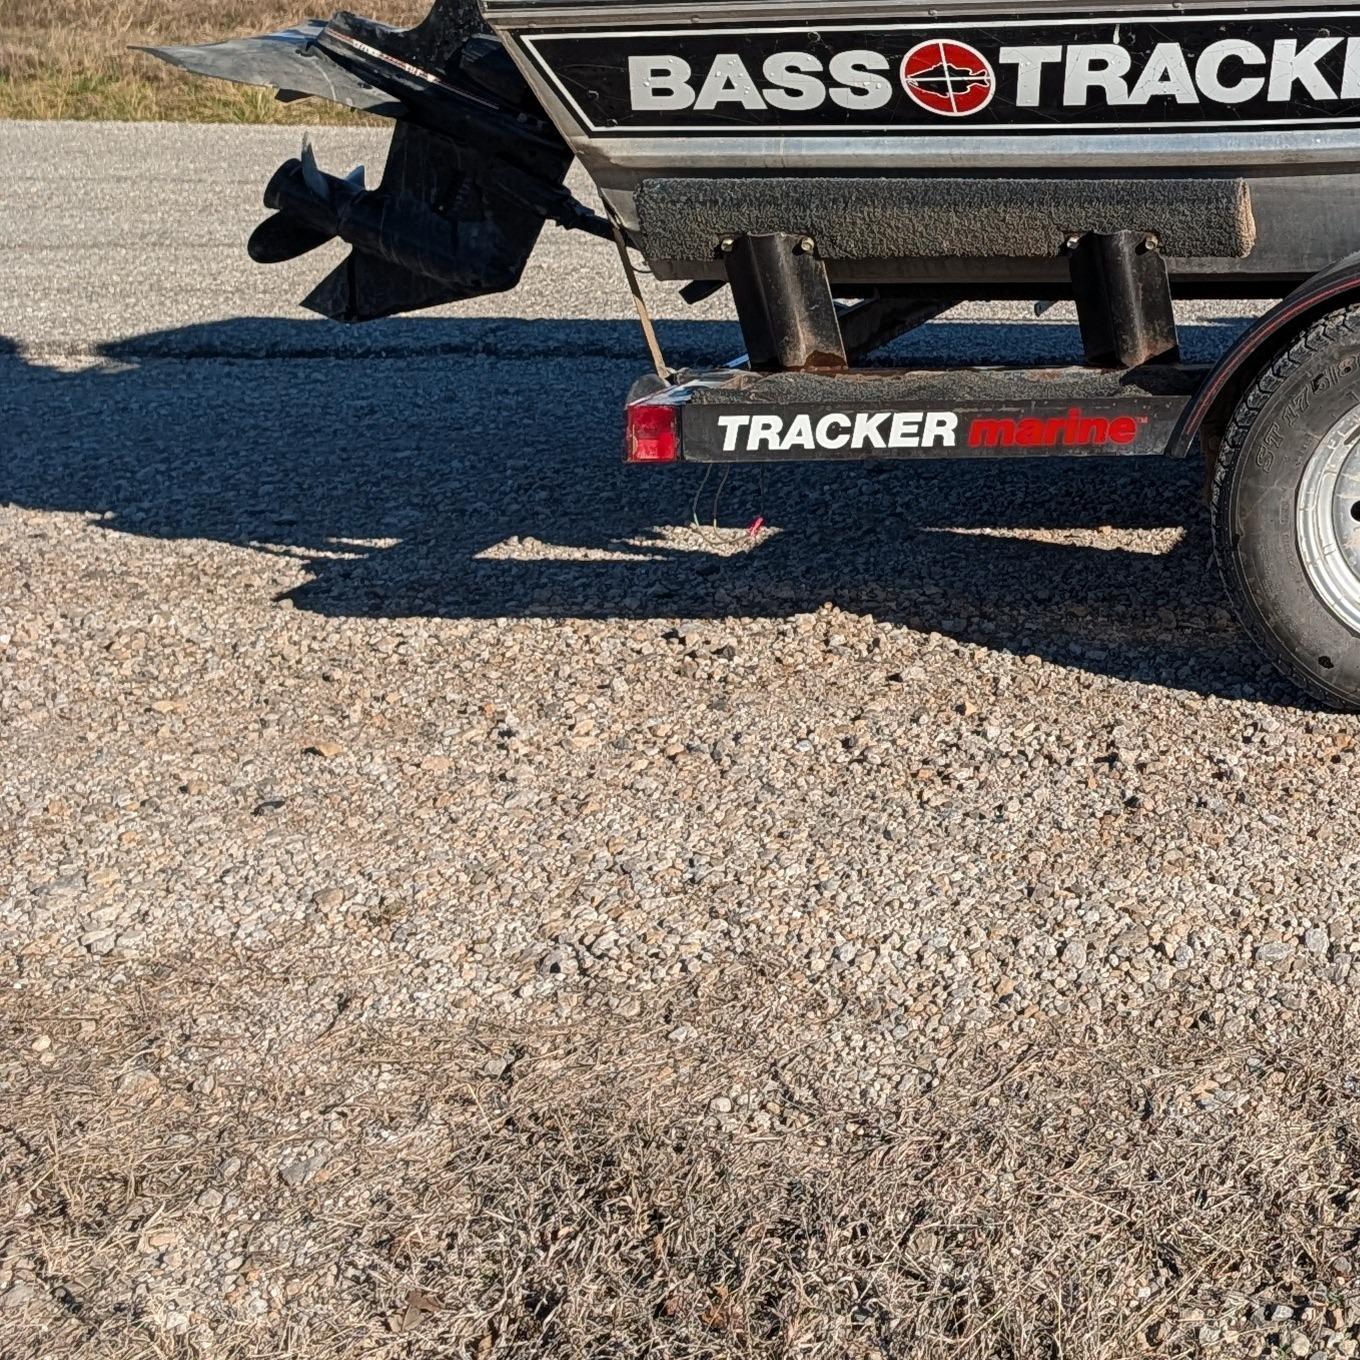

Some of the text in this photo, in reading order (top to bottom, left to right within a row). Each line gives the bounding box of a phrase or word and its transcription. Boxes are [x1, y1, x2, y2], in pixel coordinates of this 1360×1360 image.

[627, 49, 893, 111] BASS
[717, 411, 959, 451] TRACKER
[967, 406, 1137, 447] marine
